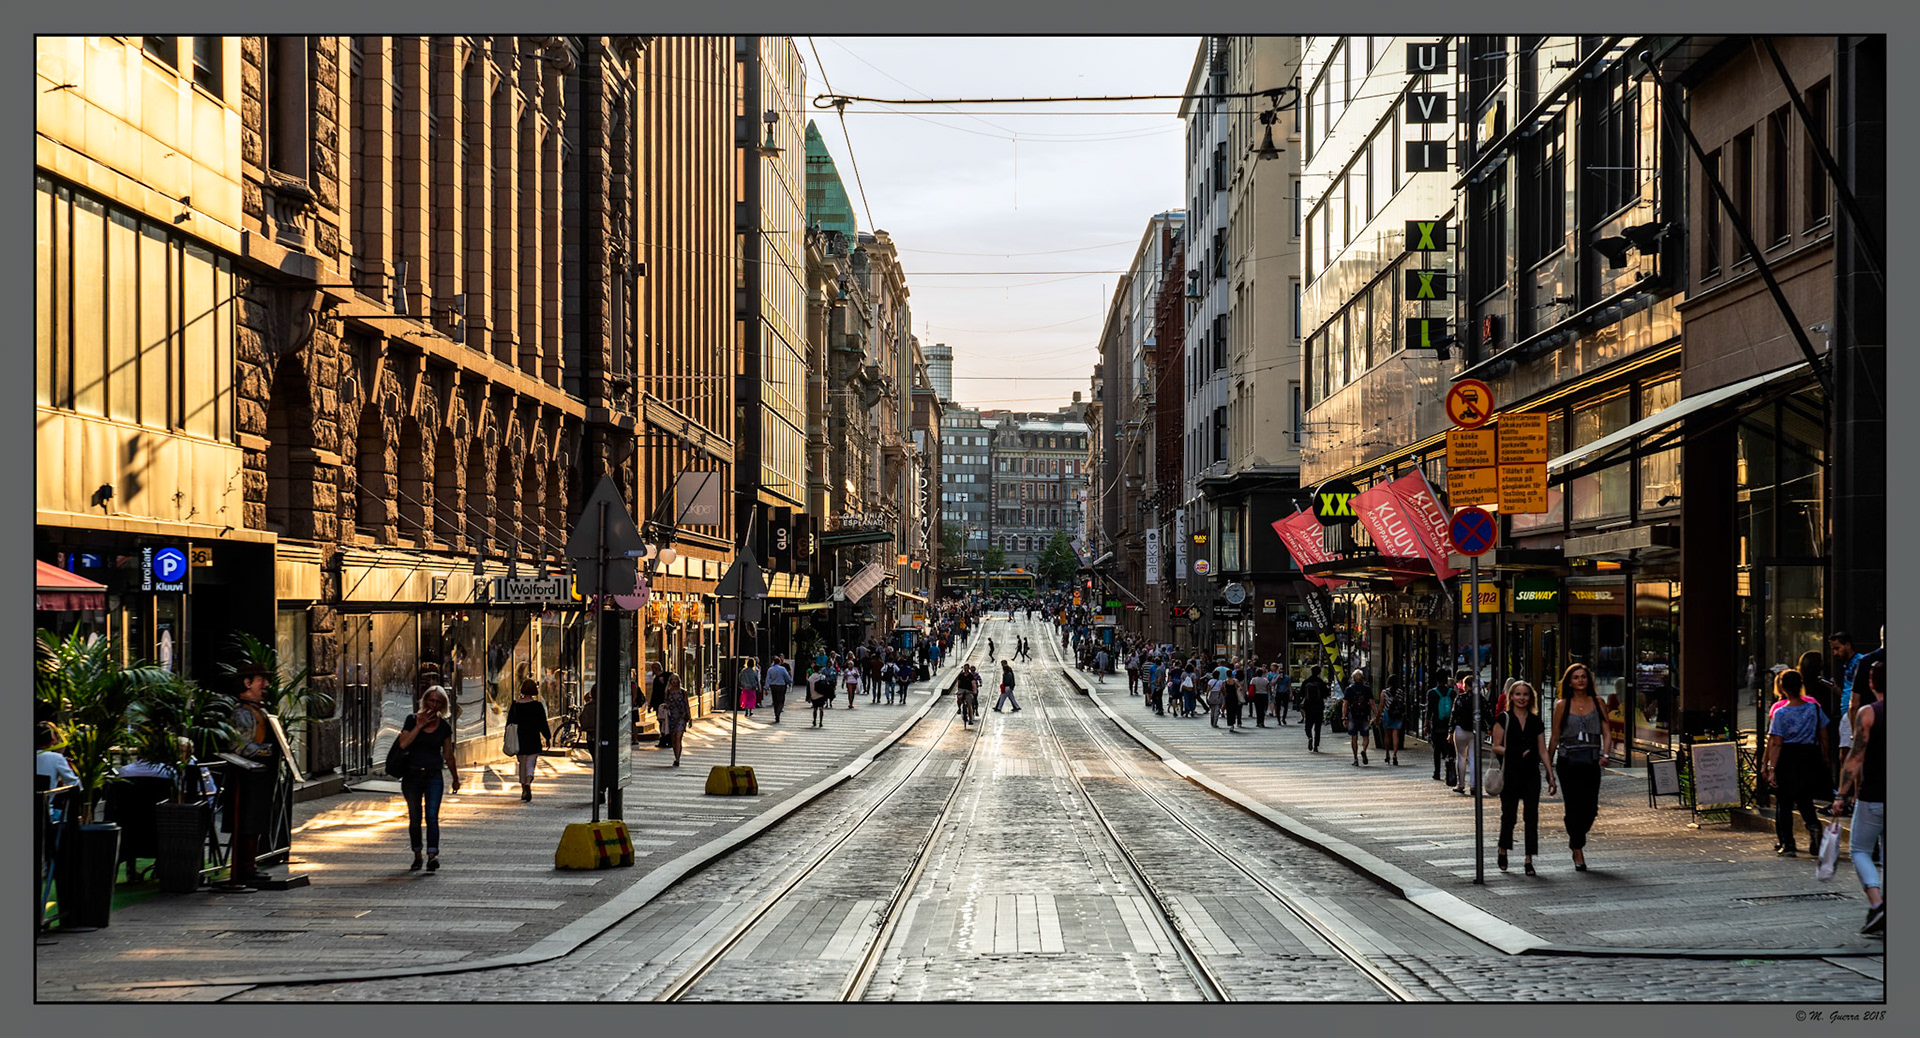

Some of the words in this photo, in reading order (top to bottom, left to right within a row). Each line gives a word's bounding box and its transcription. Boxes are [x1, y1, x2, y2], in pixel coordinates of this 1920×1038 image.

[1375, 501, 1420, 563] KLUUVI
[777, 528, 787, 551] GLO
[1429, 532, 1446, 559] CENTER
[156, 583, 183, 591] Kluuvi
[510, 583, 556, 595] Wolford
[1466, 591, 1497, 604] aepa
[1516, 591, 1557, 600] SUBWAY
